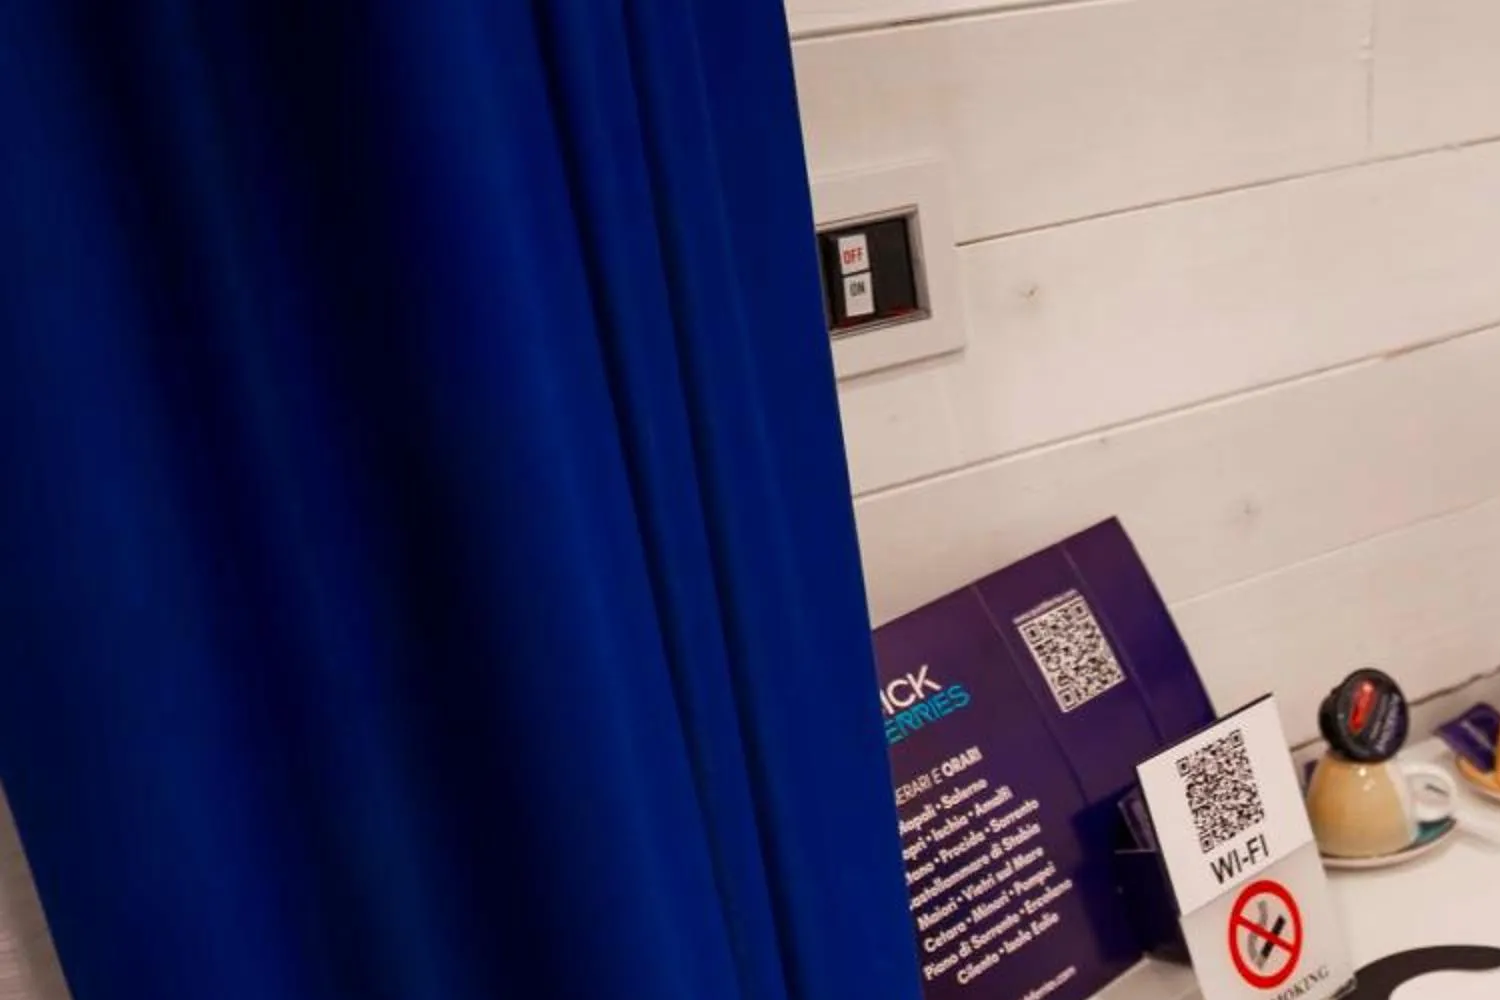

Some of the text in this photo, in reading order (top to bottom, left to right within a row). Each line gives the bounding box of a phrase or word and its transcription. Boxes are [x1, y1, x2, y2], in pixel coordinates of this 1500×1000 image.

[879, 664, 943, 717] ICK
[885, 685, 970, 744] ERRIES
[895, 747, 983, 807] ERARI E ORARI
[941, 778, 988, 810] Salerno
[901, 834, 928, 861] apri
[975, 785, 1014, 817] Amalfi
[938, 831, 986, 864] Procida
[989, 799, 1040, 833] Sorrento
[908, 855, 990, 911] astellammare
[1002, 823, 1042, 851] Stabia
[1012, 846, 1045, 872] Mare
[1209, 833, 1270, 885] WI-FI
[970, 912, 1020, 950] Sorrento
